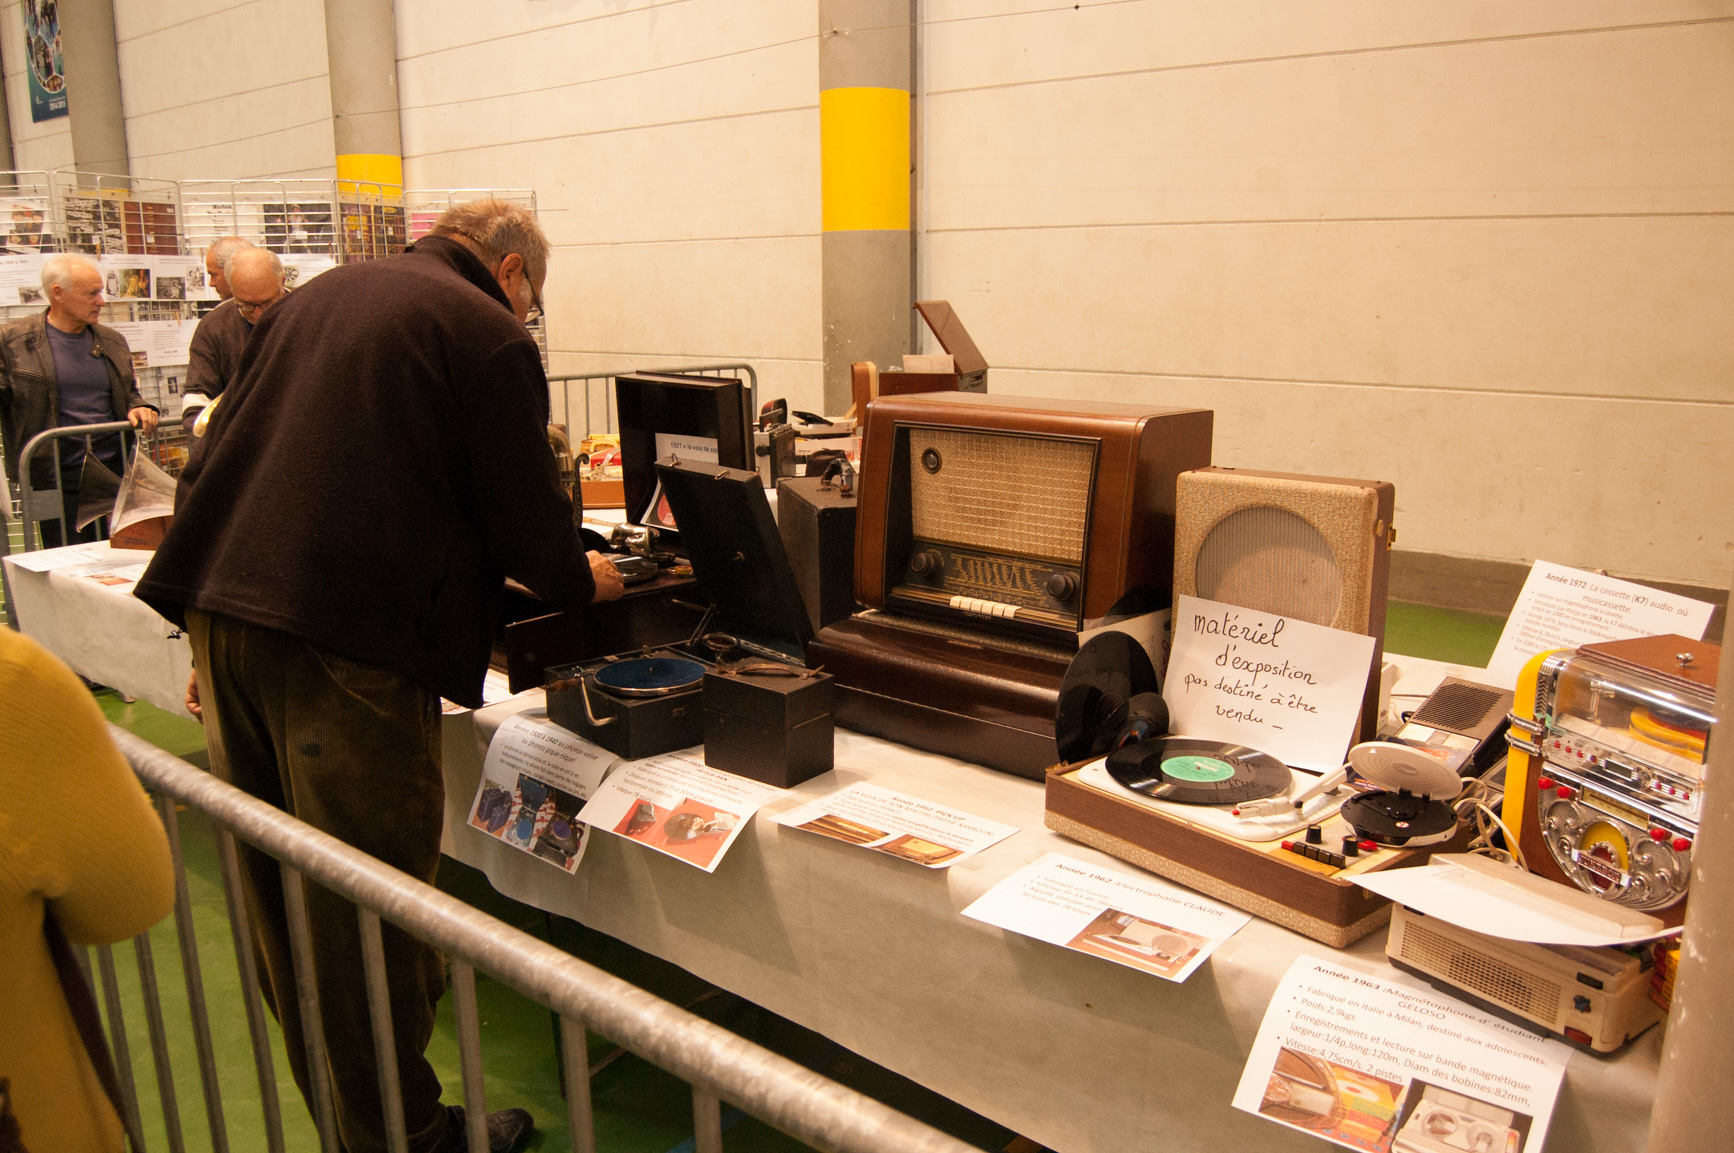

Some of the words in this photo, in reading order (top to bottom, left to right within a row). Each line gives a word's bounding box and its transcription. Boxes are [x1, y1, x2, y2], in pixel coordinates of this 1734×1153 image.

[1545, 573, 1568, 585] Année
[1568, 578, 1587, 589] 1972
[1599, 586, 1631, 600] cassette
[1631, 594, 1649, 607] (K7)
[1650, 600, 1674, 612] audio
[1677, 607, 1689, 617] où
[1582, 594, 1632, 614] musicassette.
[1194, 612, 1285, 648] matériel
[1589, 614, 1602, 622] 1963
[1215, 644, 1318, 686] d'exposition
[1184, 673, 1208, 694] pas
[1214, 676, 1268, 701] destiné
[1270, 692, 1283, 706] à
[1288, 694, 1318, 714] être
[1216, 704, 1264, 724] vendu
[1055, 863, 1087, 876] Année
[1088, 872, 1113, 884] 1962
[1183, 901, 1226, 918] CLAUDE
[1301, 998, 1356, 1021] Poids:2,9kgs
[1313, 966, 1350, 980] Année
[1352, 978, 1380, 990] 1963
[1493, 1023, 1549, 1044] étudiant.
[1398, 1001, 1446, 1020] GELOSO
[1307, 986, 1346, 1004] Fabriqué
[1362, 1003, 1384, 1015] Italie
[1394, 1013, 1424, 1028] Milan,
[1426, 1024, 1463, 1040] destiné
[1465, 1036, 1482, 1046] aux
[1484, 1042, 1547, 1066] adolescents.
[1295, 1011, 1368, 1040] Enregistrements
[1370, 1036, 1380, 1044] et
[1382, 1038, 1416, 1055] lecture
[1418, 1050, 1433, 1060] sur
[1436, 1054, 1467, 1071] bande
[1469, 1066, 1533, 1093] magnétique.
[1403, 1058, 1429, 1074] Diam
[1432, 1067, 1449, 1080] des
[1366, 1064, 1373, 1072] 2
[1375, 1068, 1403, 1083] pistes
